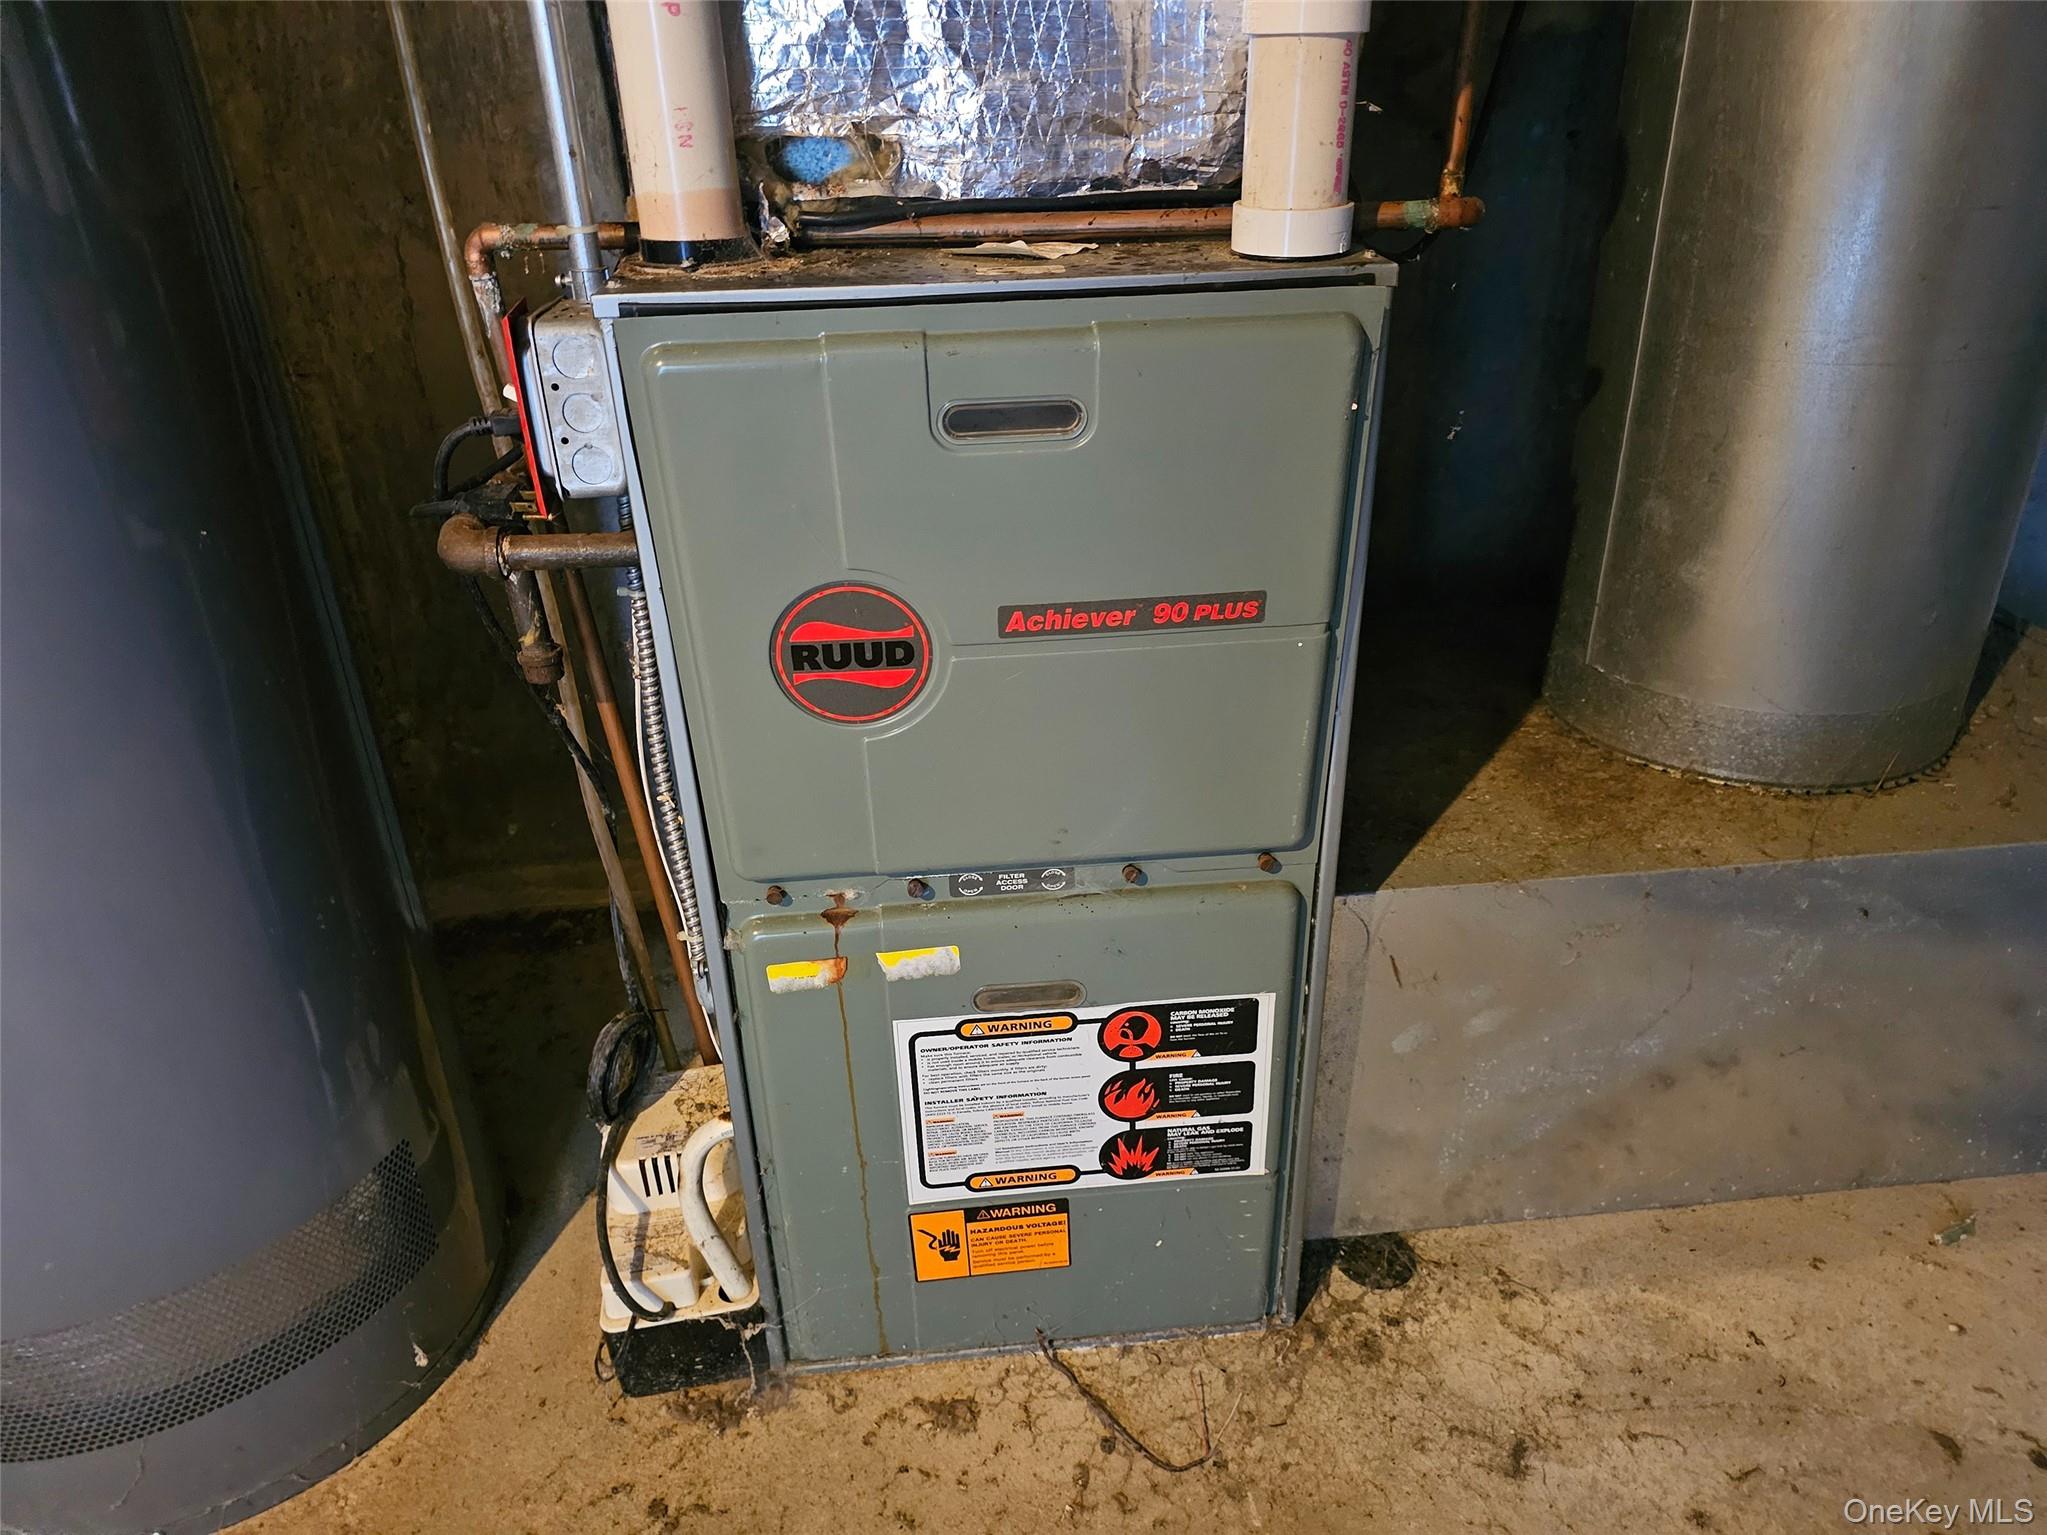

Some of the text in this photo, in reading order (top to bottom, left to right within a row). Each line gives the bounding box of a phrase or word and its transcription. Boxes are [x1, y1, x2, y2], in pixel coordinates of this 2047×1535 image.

[1341, 62, 1351, 96] ASTM
[1006, 599, 1258, 633] Achiever 90 PLUS
[791, 641, 915, 671] RUUD
[987, 1020, 1052, 1033] WARNING
[920, 1044, 988, 1053] OWNER/OPERATOR
[1022, 1037, 1072, 1045] INFORMATION
[995, 1172, 1057, 1185] WARNING
[990, 1203, 1057, 1218] WARNING
[970, 1220, 1066, 1234] HAZARDOUS VOLTAGE!
